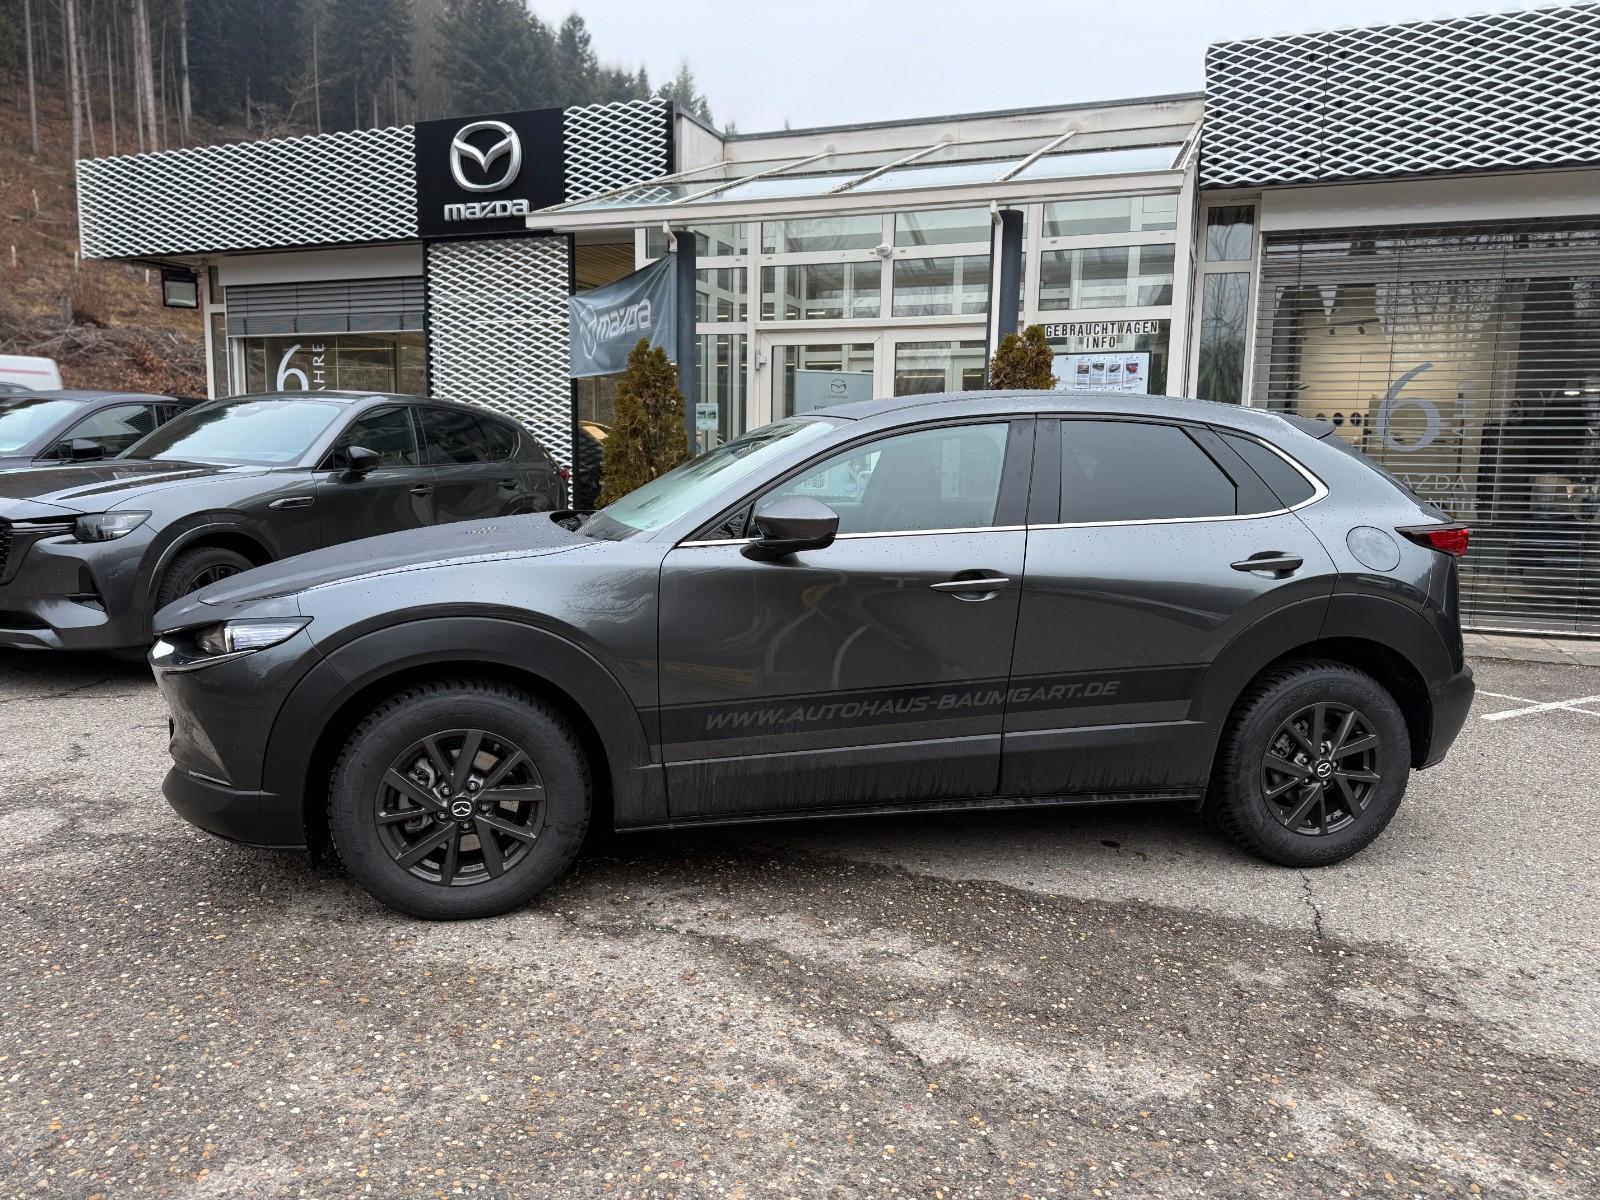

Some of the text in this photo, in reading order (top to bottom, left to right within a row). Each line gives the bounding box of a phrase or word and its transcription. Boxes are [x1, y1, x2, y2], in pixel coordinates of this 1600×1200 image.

[1045, 321, 1159, 337] GEBRAUCHTWAGEN
[1086, 336, 1116, 349] INFO
[312, 343, 325, 391] HRE
[1375, 361, 1441, 452] 6
[1402, 473, 1468, 491] AZDA
[705, 680, 1122, 731] WWW.AUTOHAUS-BAUMGART.DE
